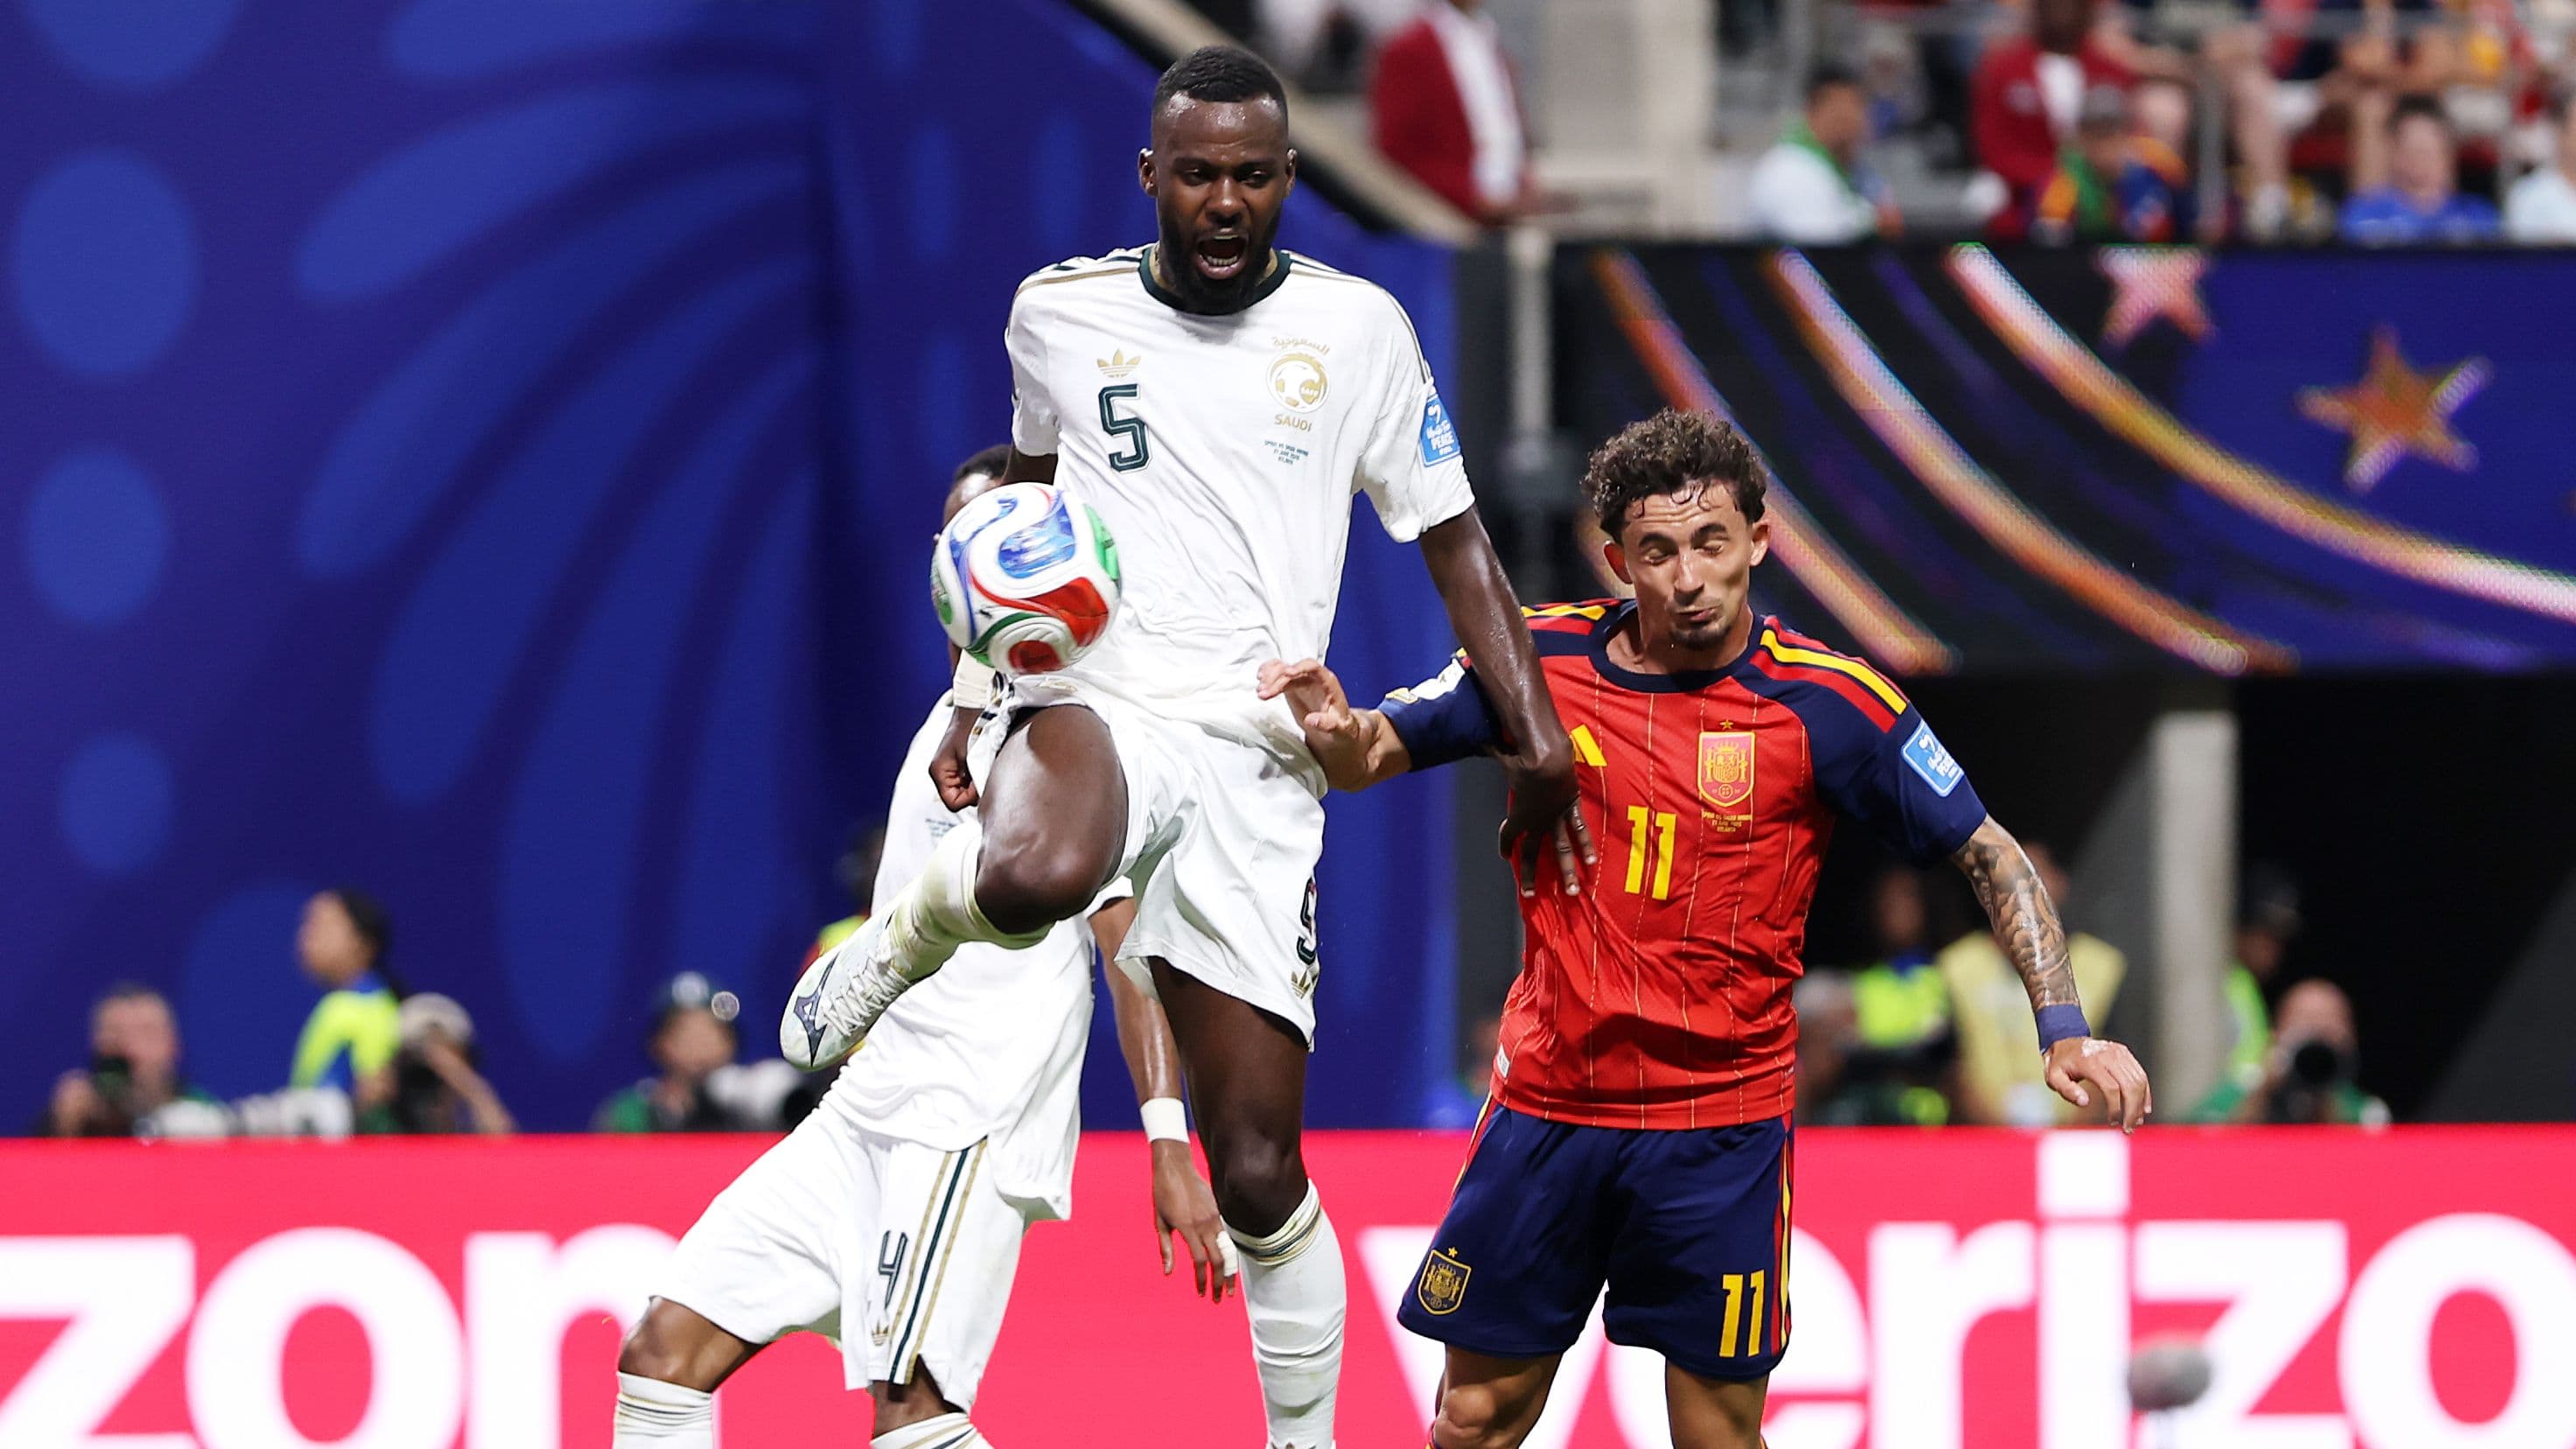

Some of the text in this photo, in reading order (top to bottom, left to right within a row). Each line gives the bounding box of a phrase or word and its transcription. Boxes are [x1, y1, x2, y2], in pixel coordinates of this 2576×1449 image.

[1098, 383, 1152, 472] 5
[1274, 413, 1312, 432] SAUDI
[1625, 804, 1677, 900] 11
[878, 1229, 908, 1310] 4
[1719, 1270, 1765, 1357] 11
